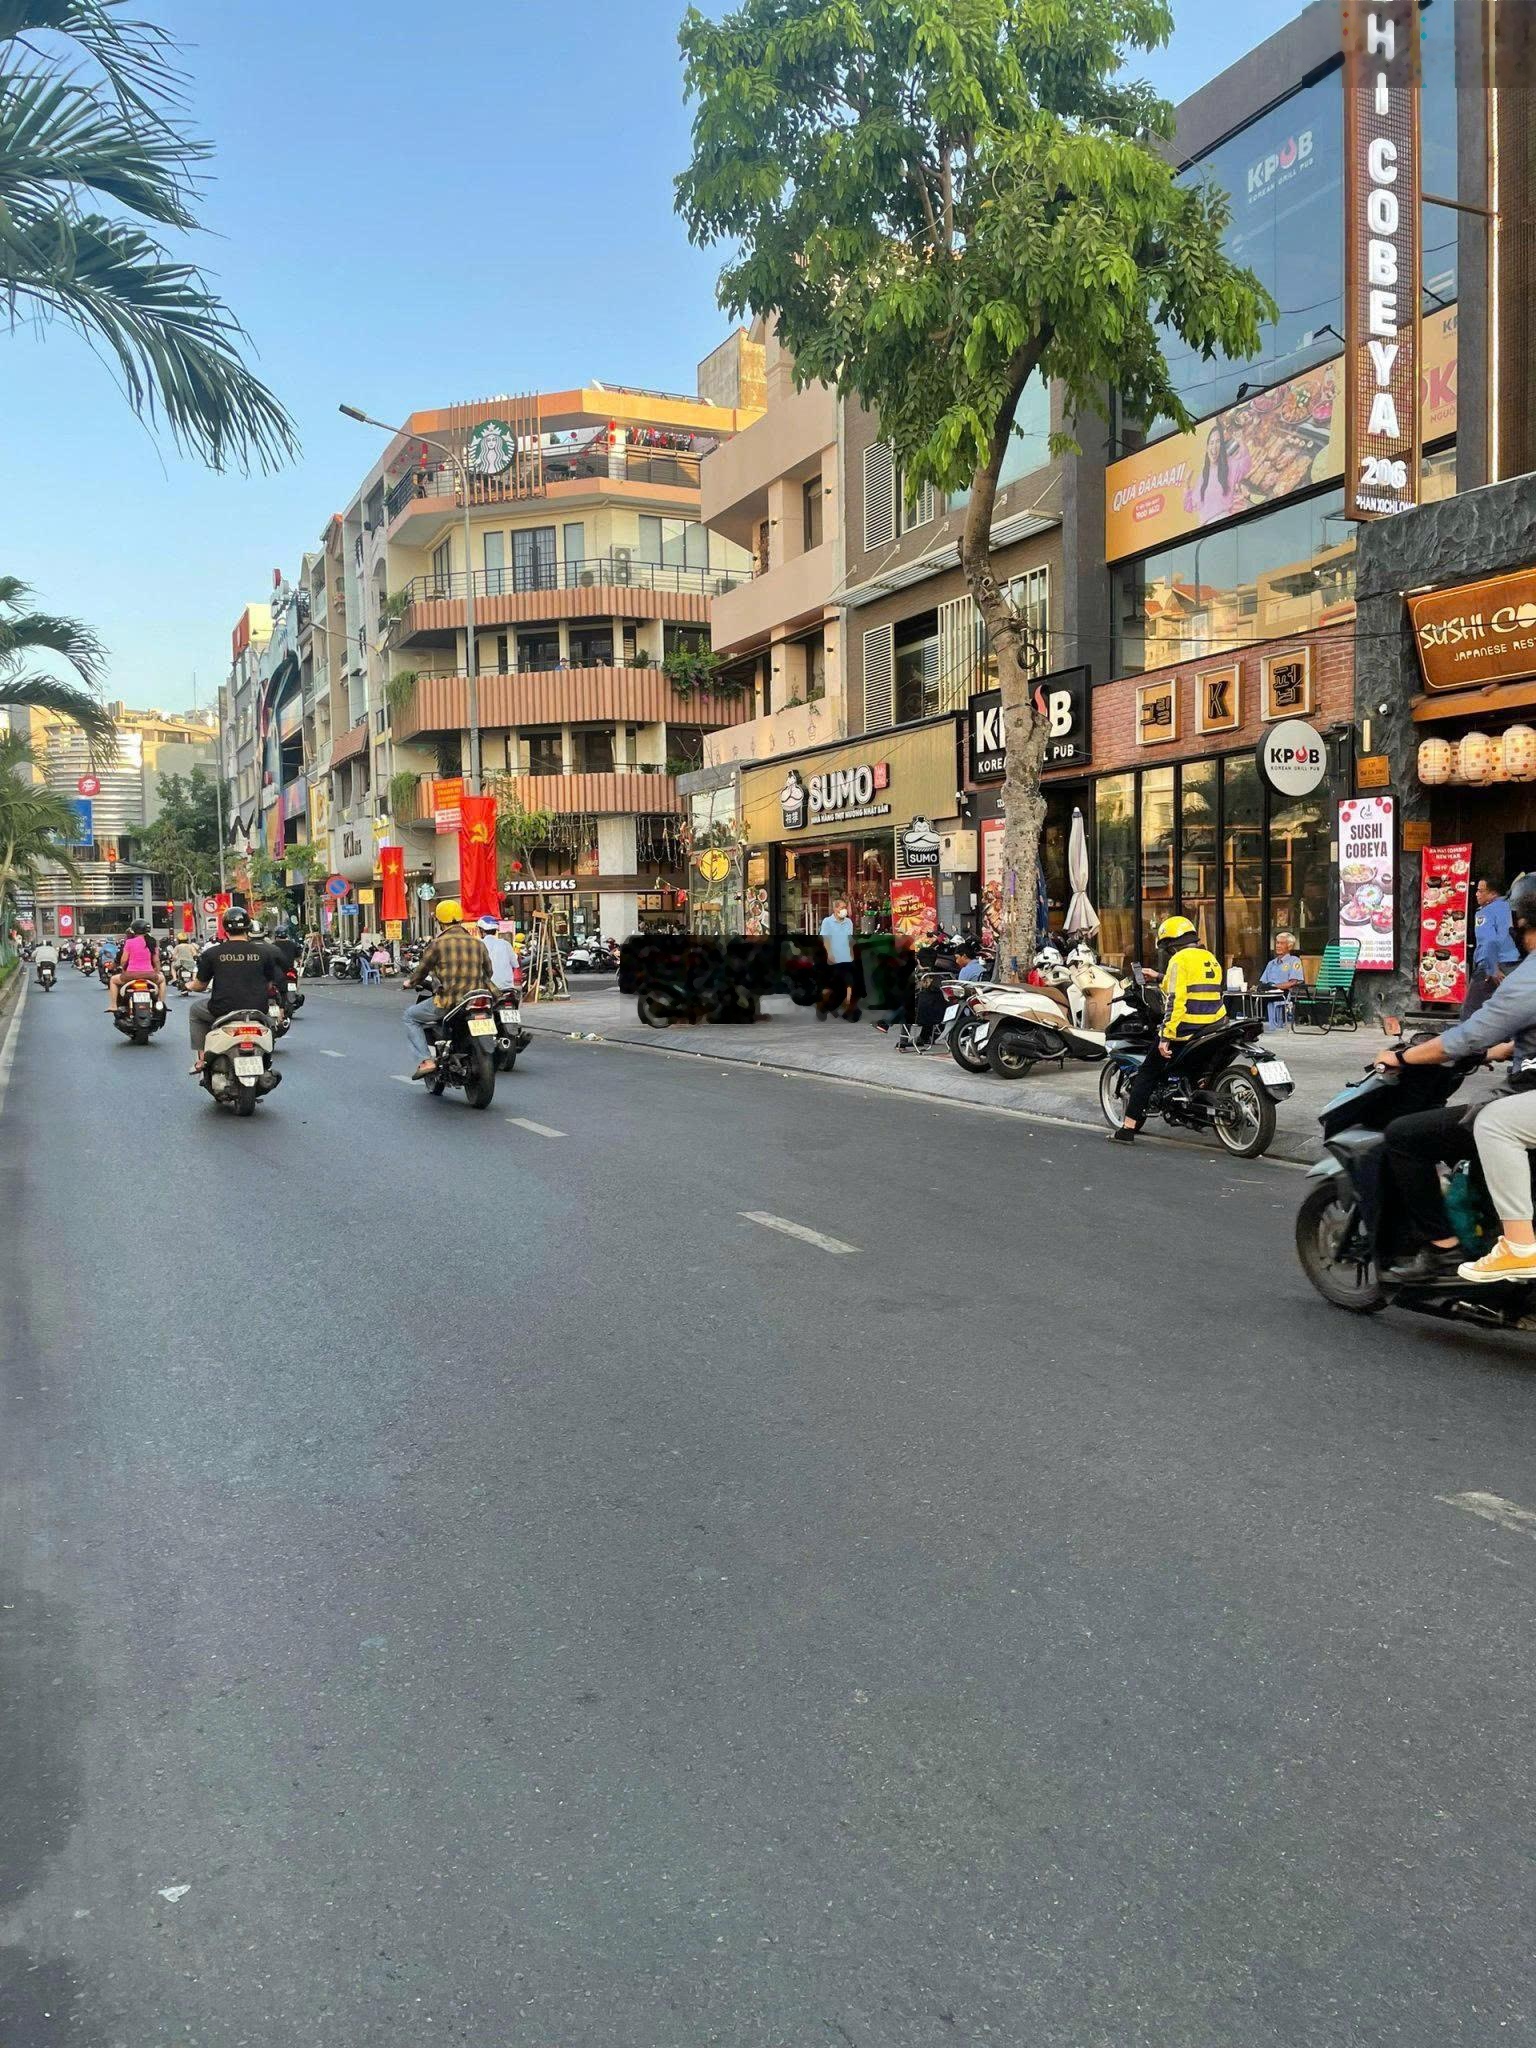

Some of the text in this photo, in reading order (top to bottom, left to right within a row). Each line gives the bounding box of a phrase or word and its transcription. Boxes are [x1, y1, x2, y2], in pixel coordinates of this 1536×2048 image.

[1248, 130, 1313, 193] KPUB
[1367, 137, 1400, 438] COBEYA
[1361, 456, 1407, 489] 206
[1420, 613, 1485, 649] SUSHI
[1454, 643, 1507, 662] JAPANESE
[1208, 680, 1229, 720] K
[1053, 743, 1074, 759] PUB
[1271, 745, 1320, 764] KPUB
[808, 764, 873, 813] SUMO
[1350, 823, 1383, 840] SUSHI
[909, 853, 938, 863] SUMO
[1346, 841, 1388, 859] COBEYA
[504, 880, 576, 891] STARBUCKS
[908, 902, 926, 911] MENU
[220, 953, 245, 962] GOLD
